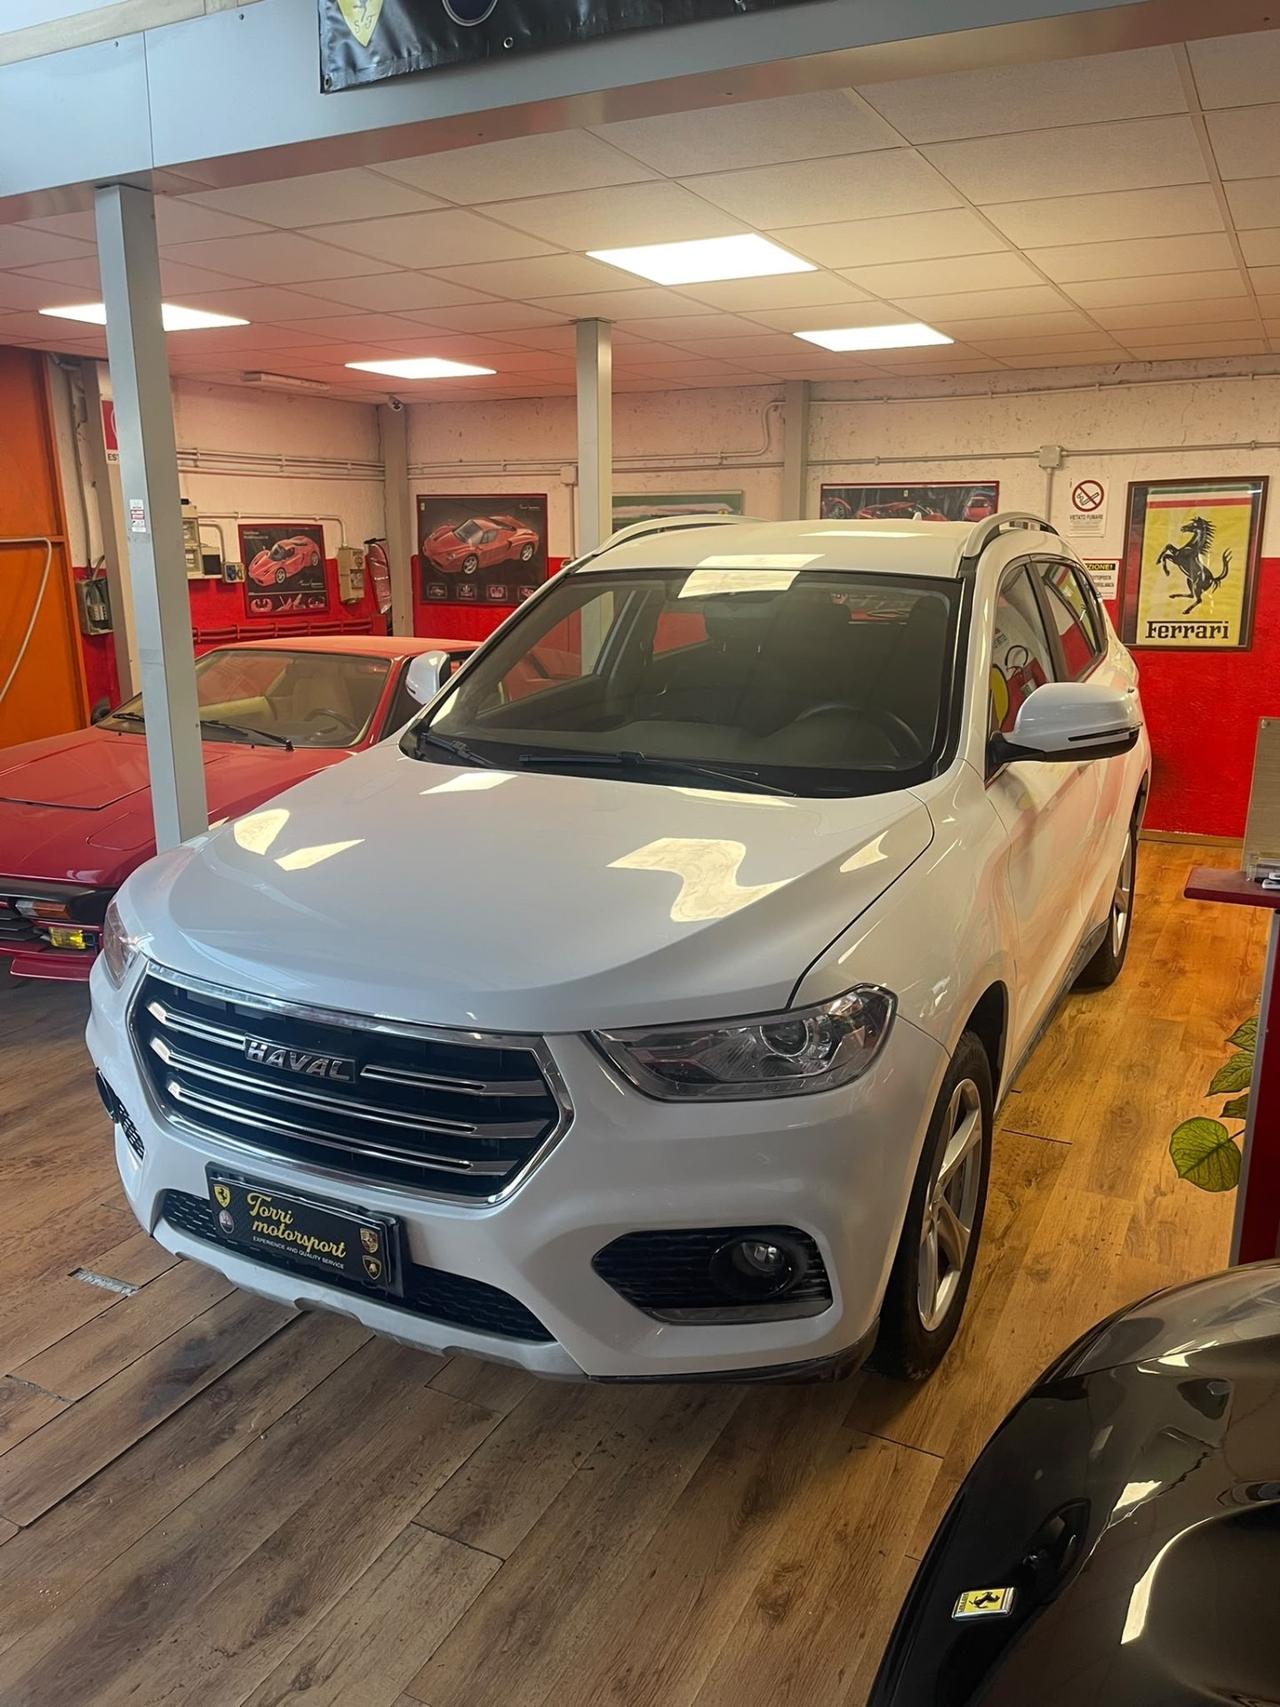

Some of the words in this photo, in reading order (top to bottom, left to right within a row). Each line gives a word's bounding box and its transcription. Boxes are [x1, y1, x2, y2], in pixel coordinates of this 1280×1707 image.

[1145, 620, 1229, 639] Ferrari
[247, 1041, 350, 1081] HAVAL
[247, 1192, 293, 1224] Torri
[252, 1220, 347, 1258] motorsport
[252, 1235, 285, 1250] EXPERIENCE
[286, 1245, 299, 1254] AND
[298, 1249, 321, 1261] QUALITY
[321, 1256, 345, 1270] SERVICE
